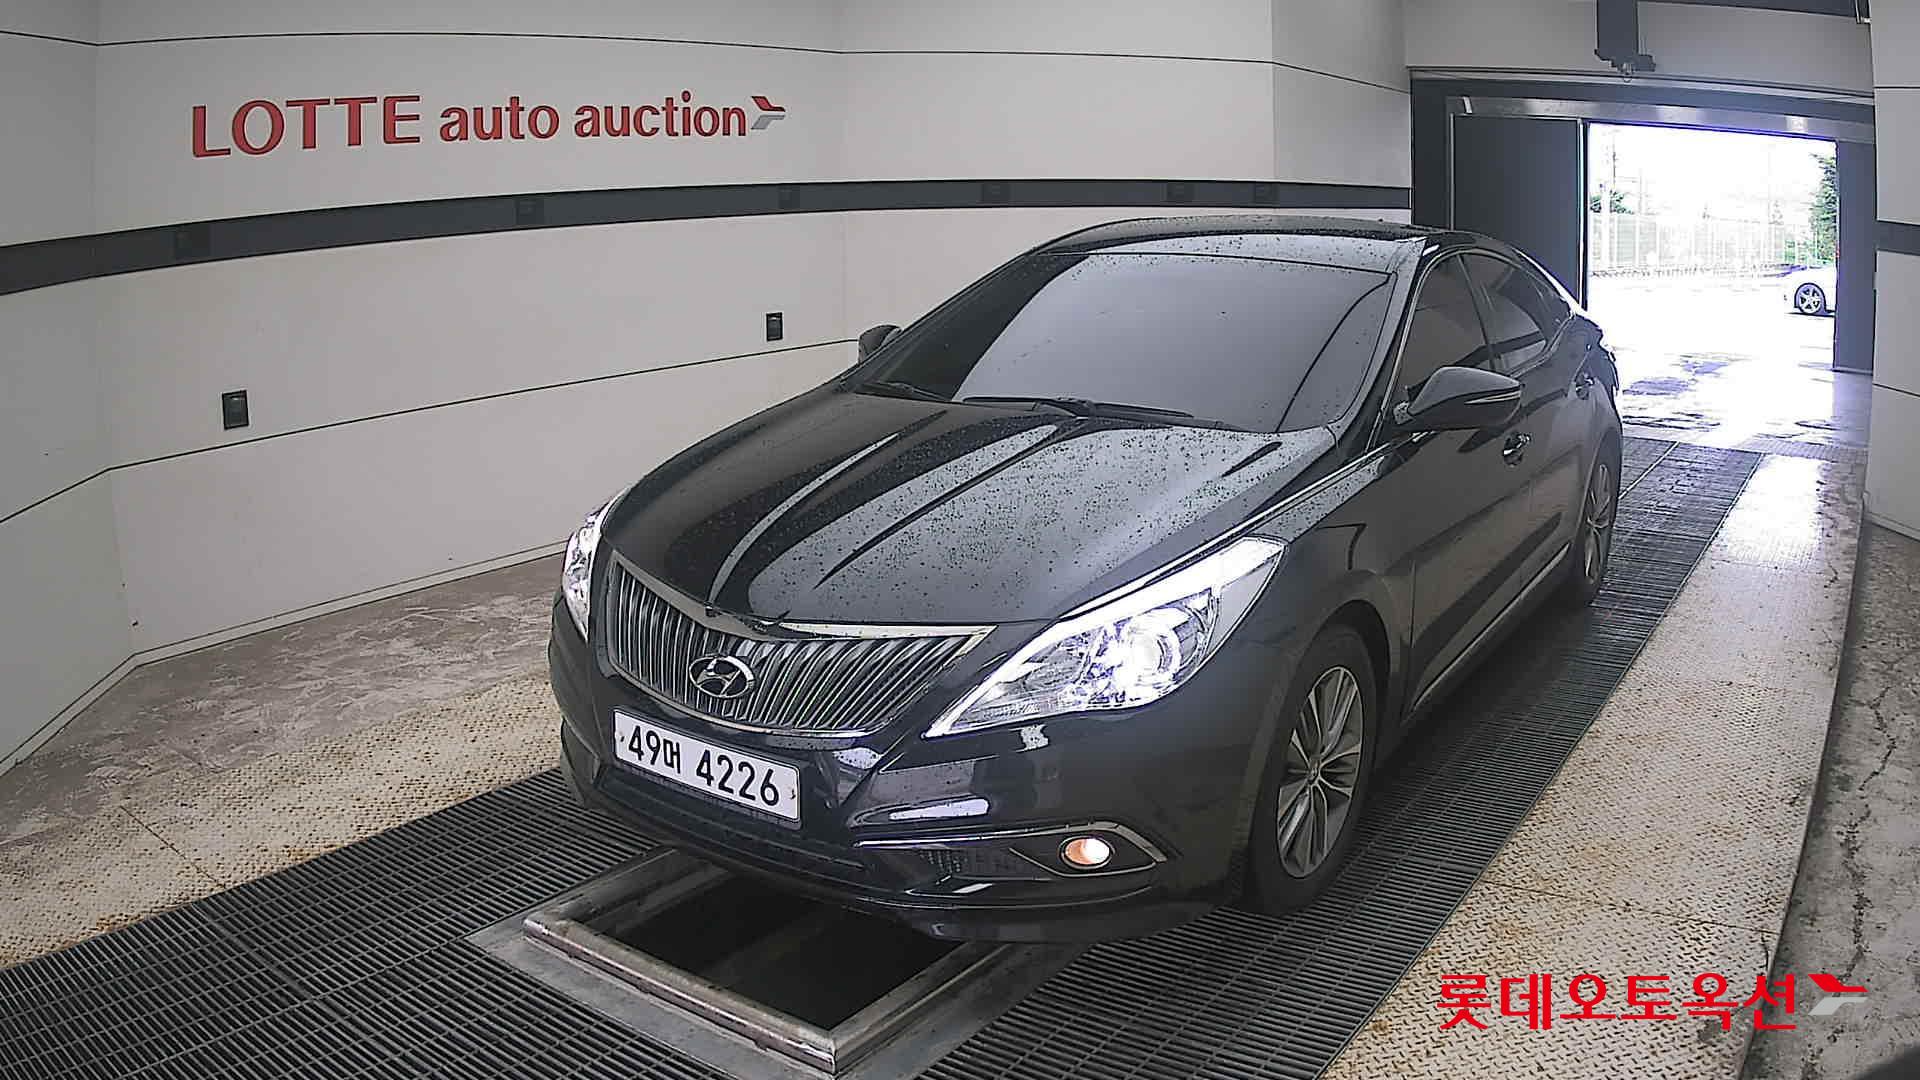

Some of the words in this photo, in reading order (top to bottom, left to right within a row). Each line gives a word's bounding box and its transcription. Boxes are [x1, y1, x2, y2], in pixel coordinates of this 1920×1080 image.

[192, 95, 421, 158] LOTTE
[439, 95, 560, 142] auto
[573, 90, 747, 138] auction
[696, 749, 779, 806] 4226
